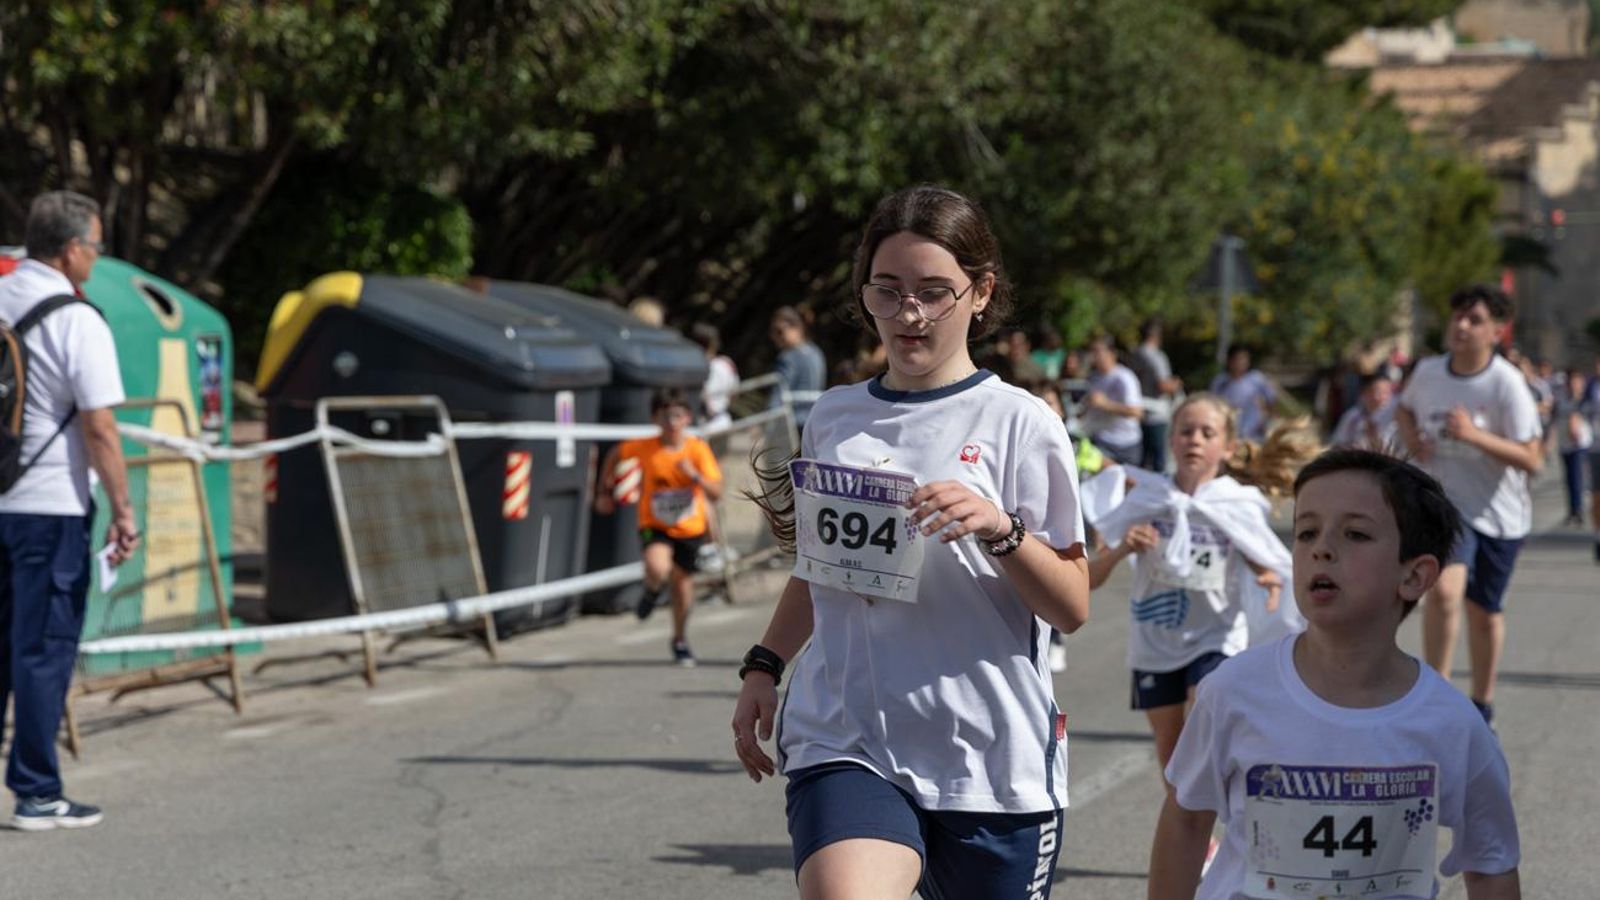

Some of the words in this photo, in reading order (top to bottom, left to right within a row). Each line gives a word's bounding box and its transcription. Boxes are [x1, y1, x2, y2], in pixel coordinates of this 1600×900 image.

[869, 486, 880, 498] LA
[817, 507, 897, 555] 694
[1280, 770, 1341, 797] XXXVI
[1343, 772, 1386, 784] CARRERA
[1388, 769, 1430, 783] ESCOLAR
[1351, 784, 1366, 797] LA
[1375, 782, 1417, 797] GLORIA
[1303, 815, 1377, 858] 44
